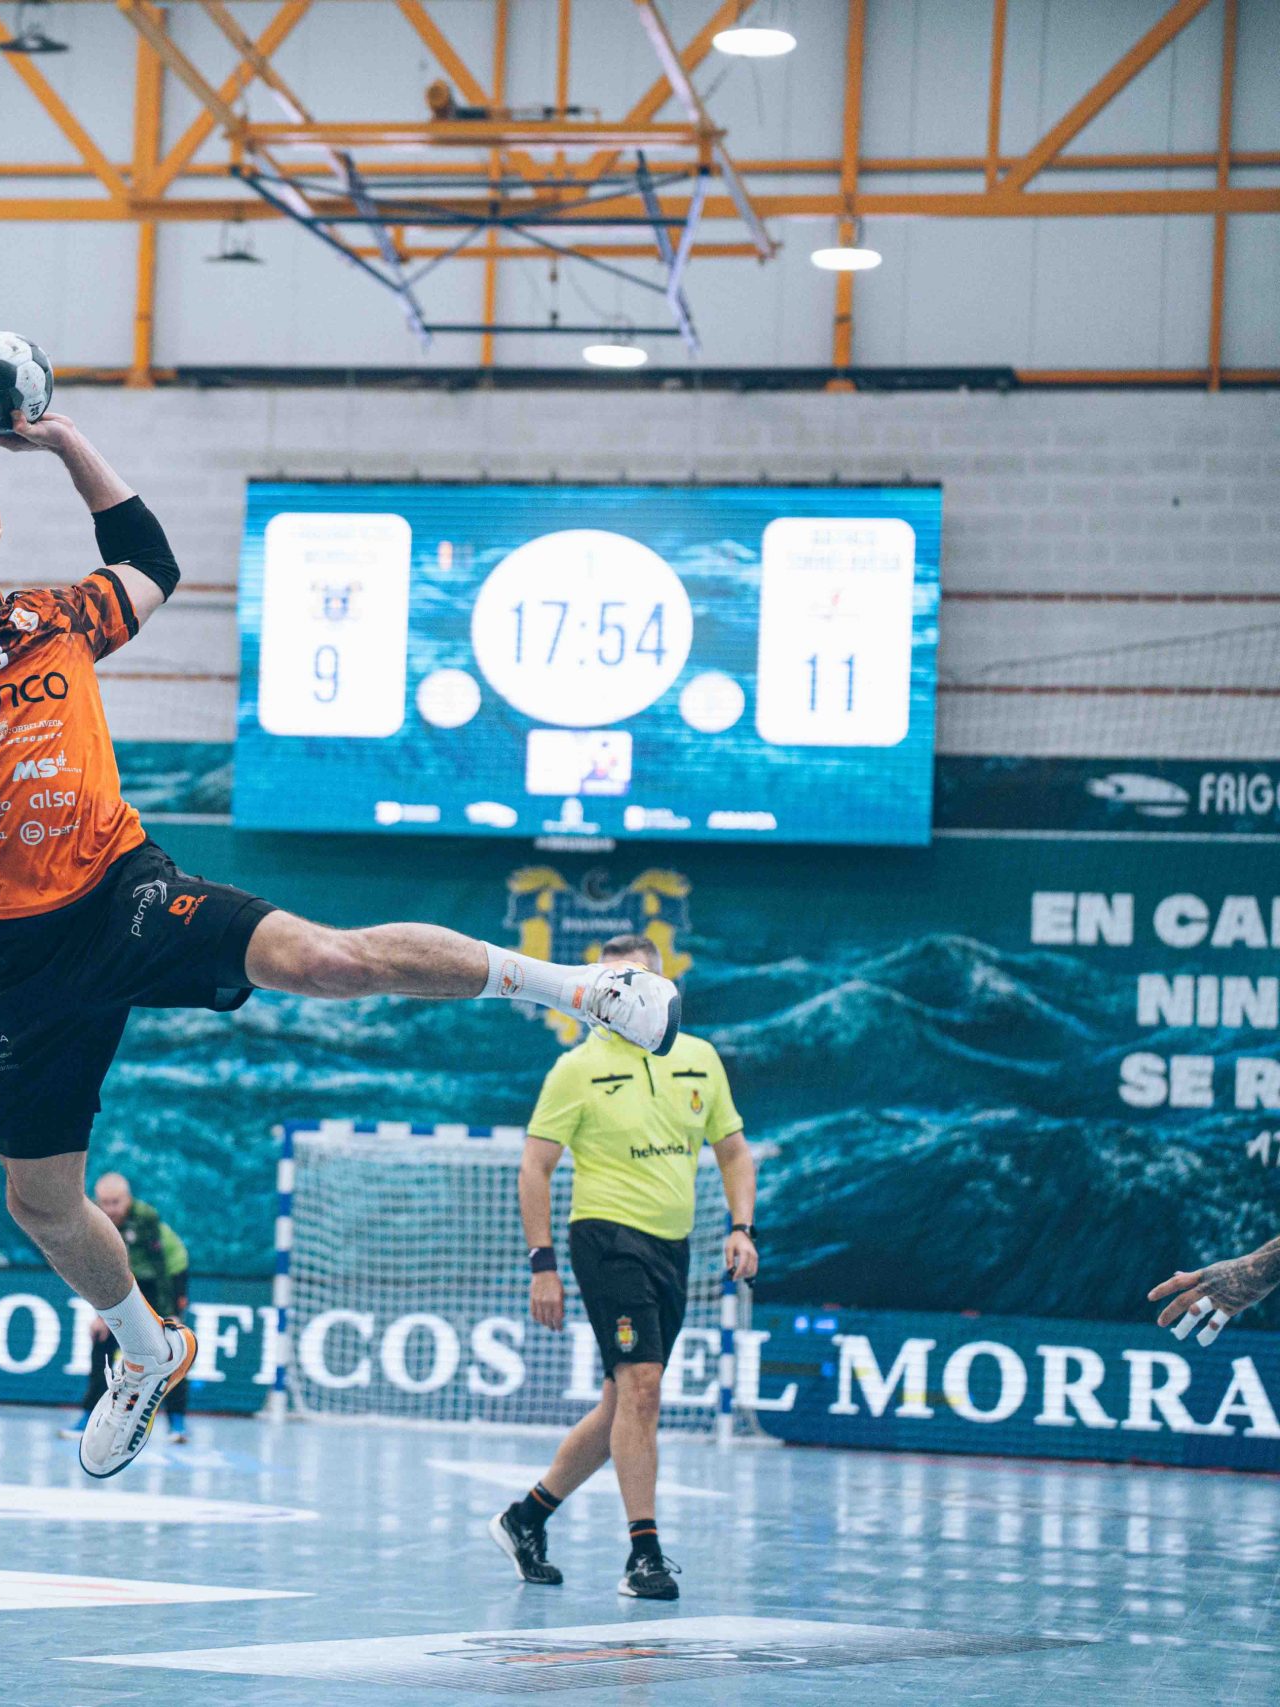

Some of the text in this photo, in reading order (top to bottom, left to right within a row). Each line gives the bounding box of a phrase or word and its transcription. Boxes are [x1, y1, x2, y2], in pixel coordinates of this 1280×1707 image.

[510, 600, 667, 667] 17:54
[313, 644, 340, 704] 9
[805, 653, 856, 713] 11
[29, 789, 76, 809] alsa
[1198, 771, 1280, 817] FRIG
[1030, 890, 1280, 949] EN CA
[1118, 1052, 1216, 1108] SE
[562, 1318, 798, 1412] EL
